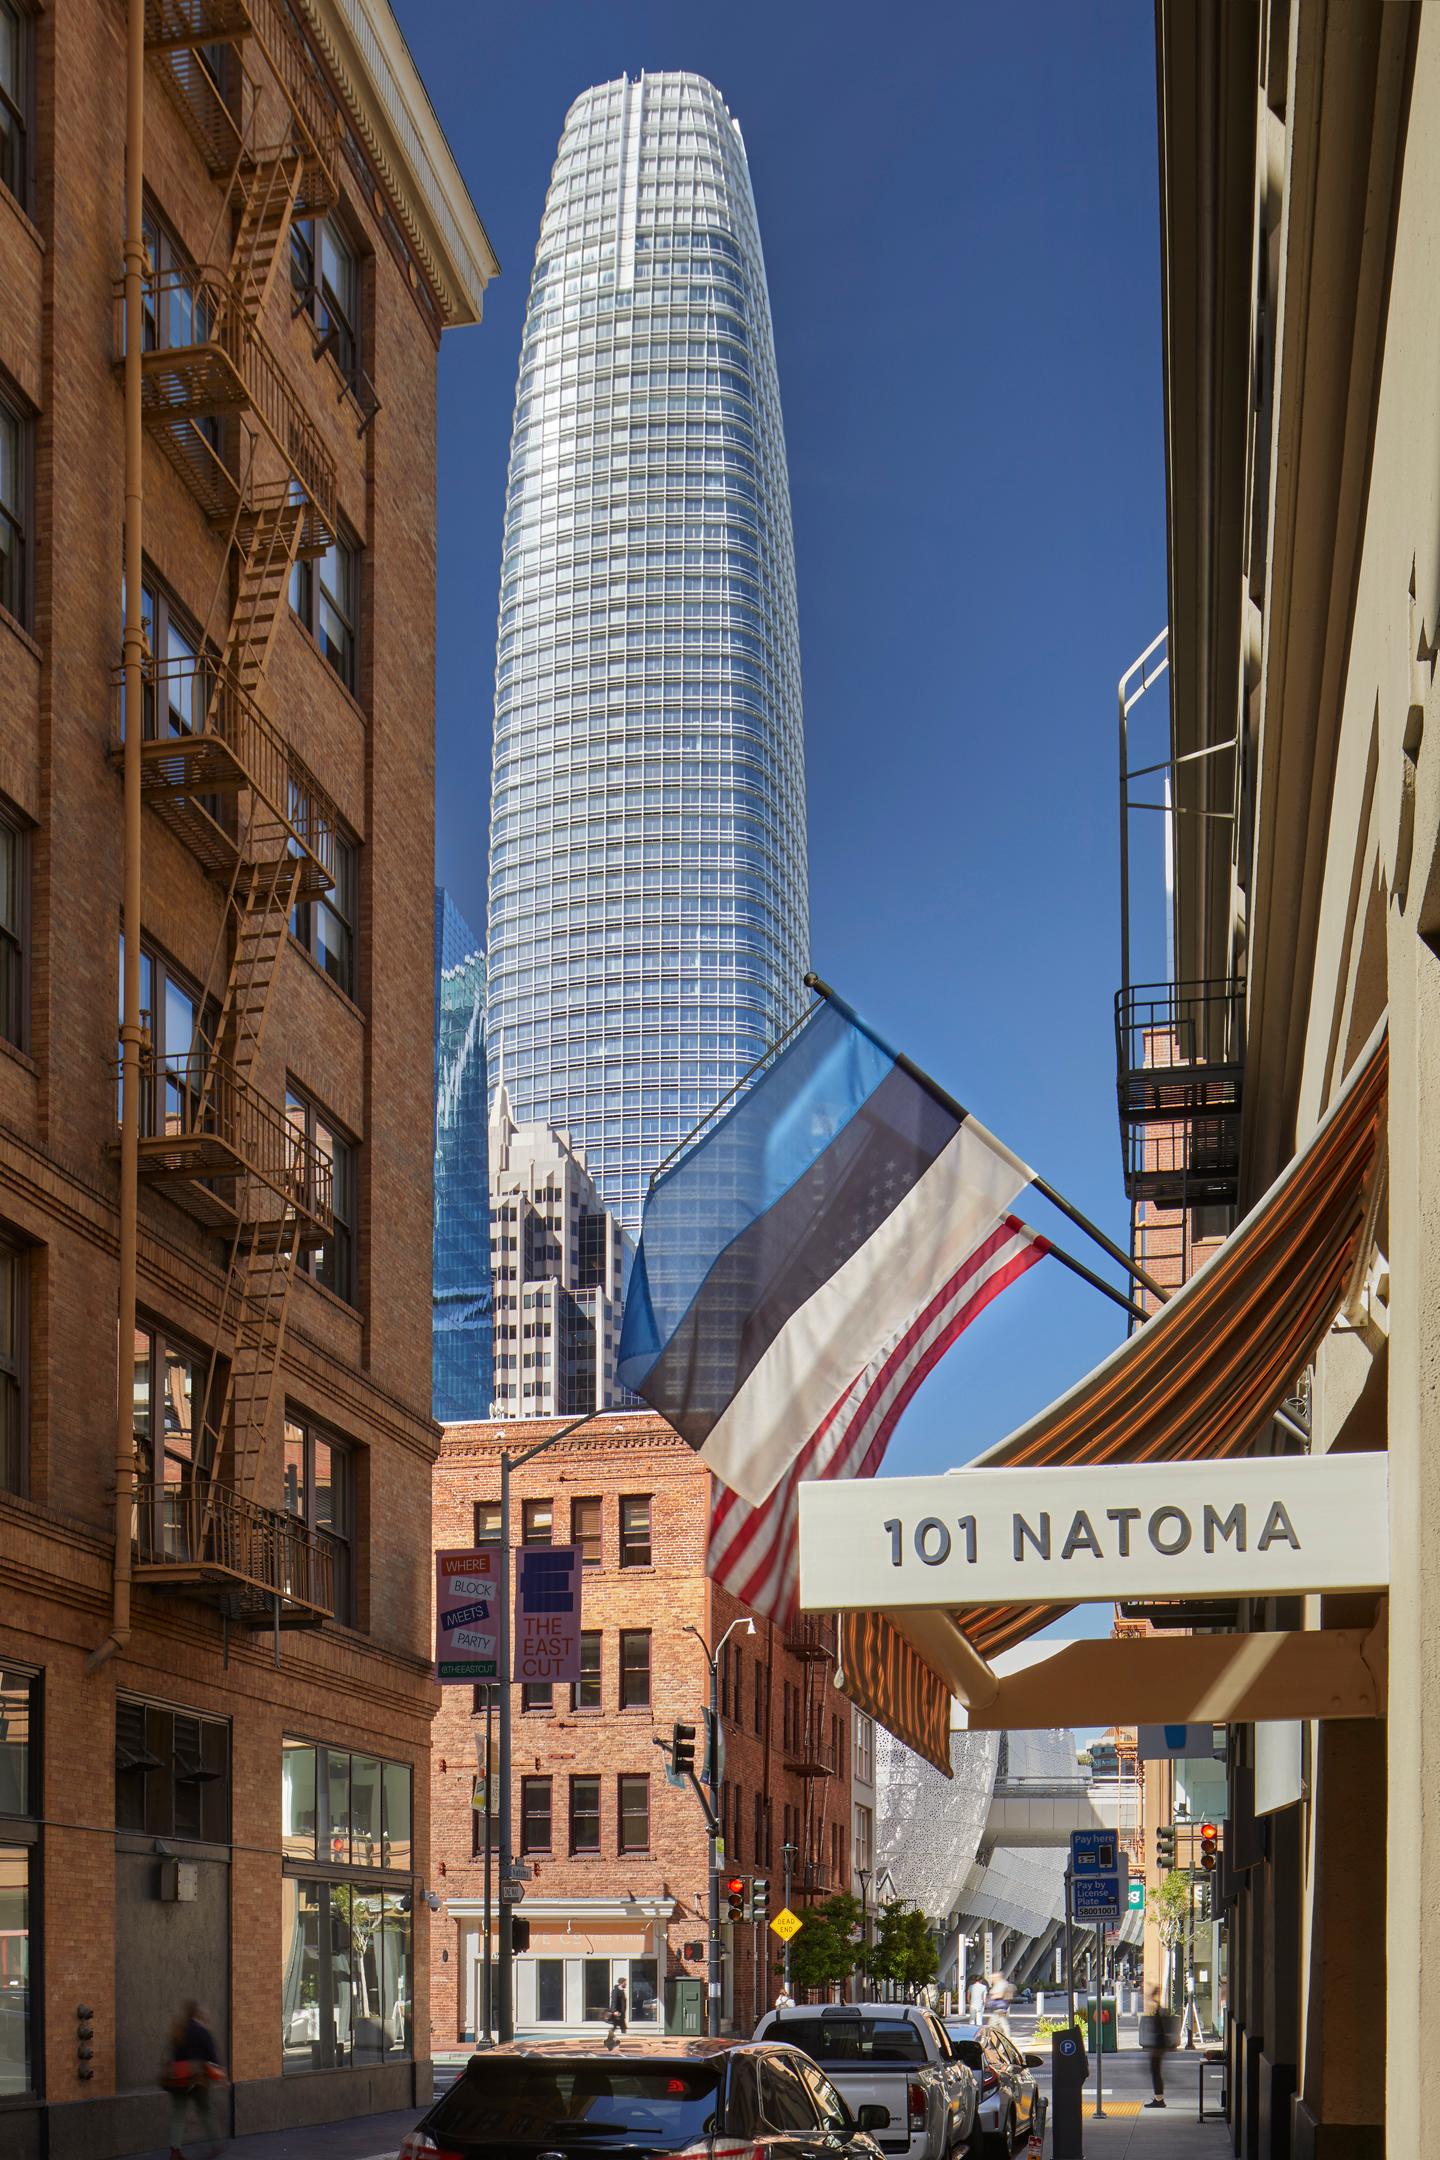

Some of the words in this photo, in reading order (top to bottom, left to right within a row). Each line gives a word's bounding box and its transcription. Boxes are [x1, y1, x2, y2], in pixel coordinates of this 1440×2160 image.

[884, 1514, 977, 1567] 101
[1013, 1501, 1301, 1562] NATOMA
[446, 1558, 486, 1573] WHERE
[454, 1580, 492, 1596] BLOCK
[446, 1605, 484, 1627] MEETS
[523, 1617, 562, 1635] THE
[457, 1633, 490, 1649] PARTY
[523, 1638, 574, 1656] EAST
[441, 1664, 494, 1674] @THEEASTCUT
[522, 1659, 565, 1677] CUT
[1074, 1835, 1092, 1844] Pay
[1094, 1834, 1115, 1842] here
[1077, 1881, 1093, 1889] Pay
[1095, 1881, 1106, 1889] by
[1077, 1888, 1109, 1897] License
[1079, 1907, 1116, 1915] 58001001
